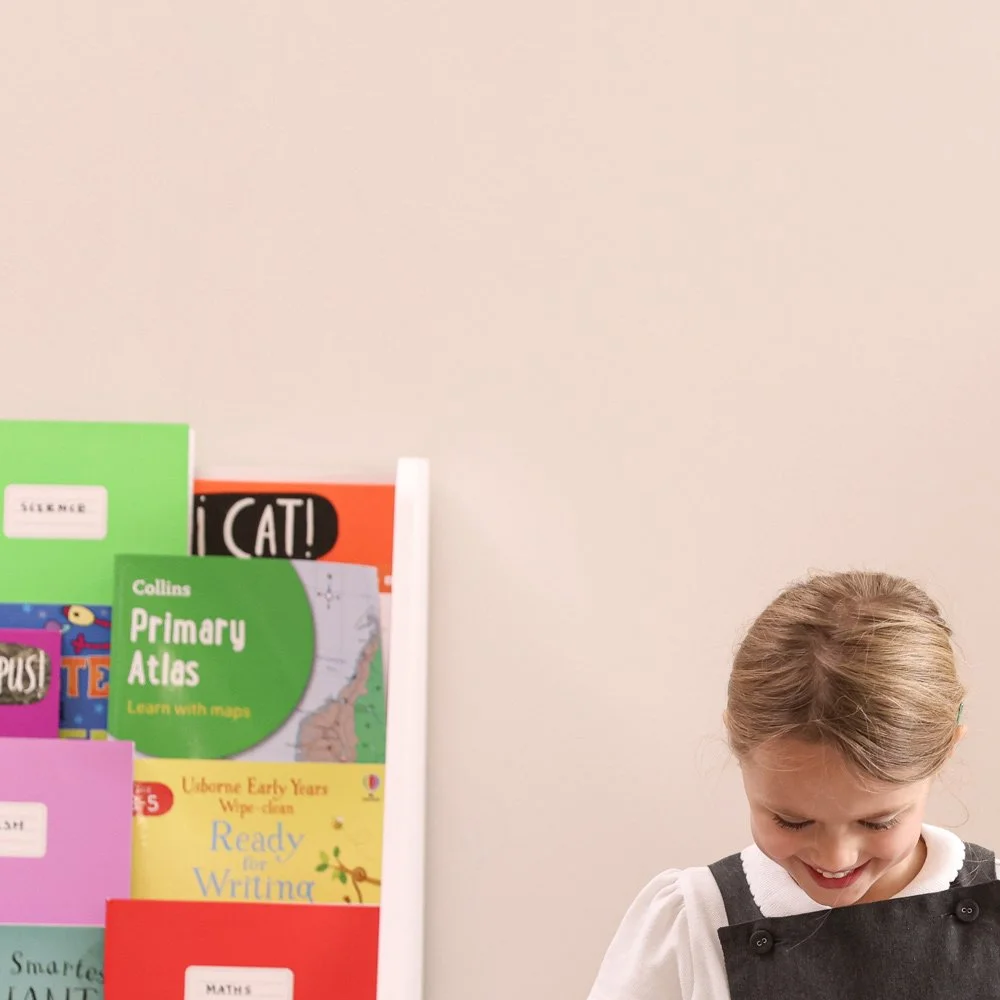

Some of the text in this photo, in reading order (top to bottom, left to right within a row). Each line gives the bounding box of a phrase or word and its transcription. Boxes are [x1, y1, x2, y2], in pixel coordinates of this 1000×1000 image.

[21, 502, 87, 514] SCIENCE
[222, 496, 315, 560] CAT!
[131, 578, 192, 597] Collins
[129, 606, 247, 653] Primary
[127, 649, 200, 687] Atlas
[126, 699, 252, 720] Learn with maps
[181, 776, 329, 800] Usborne Early Years
[210, 819, 306, 864] Ready
[242, 855, 268, 873] for
[192, 866, 316, 902] Writing
[205, 983, 253, 996] MATHS
